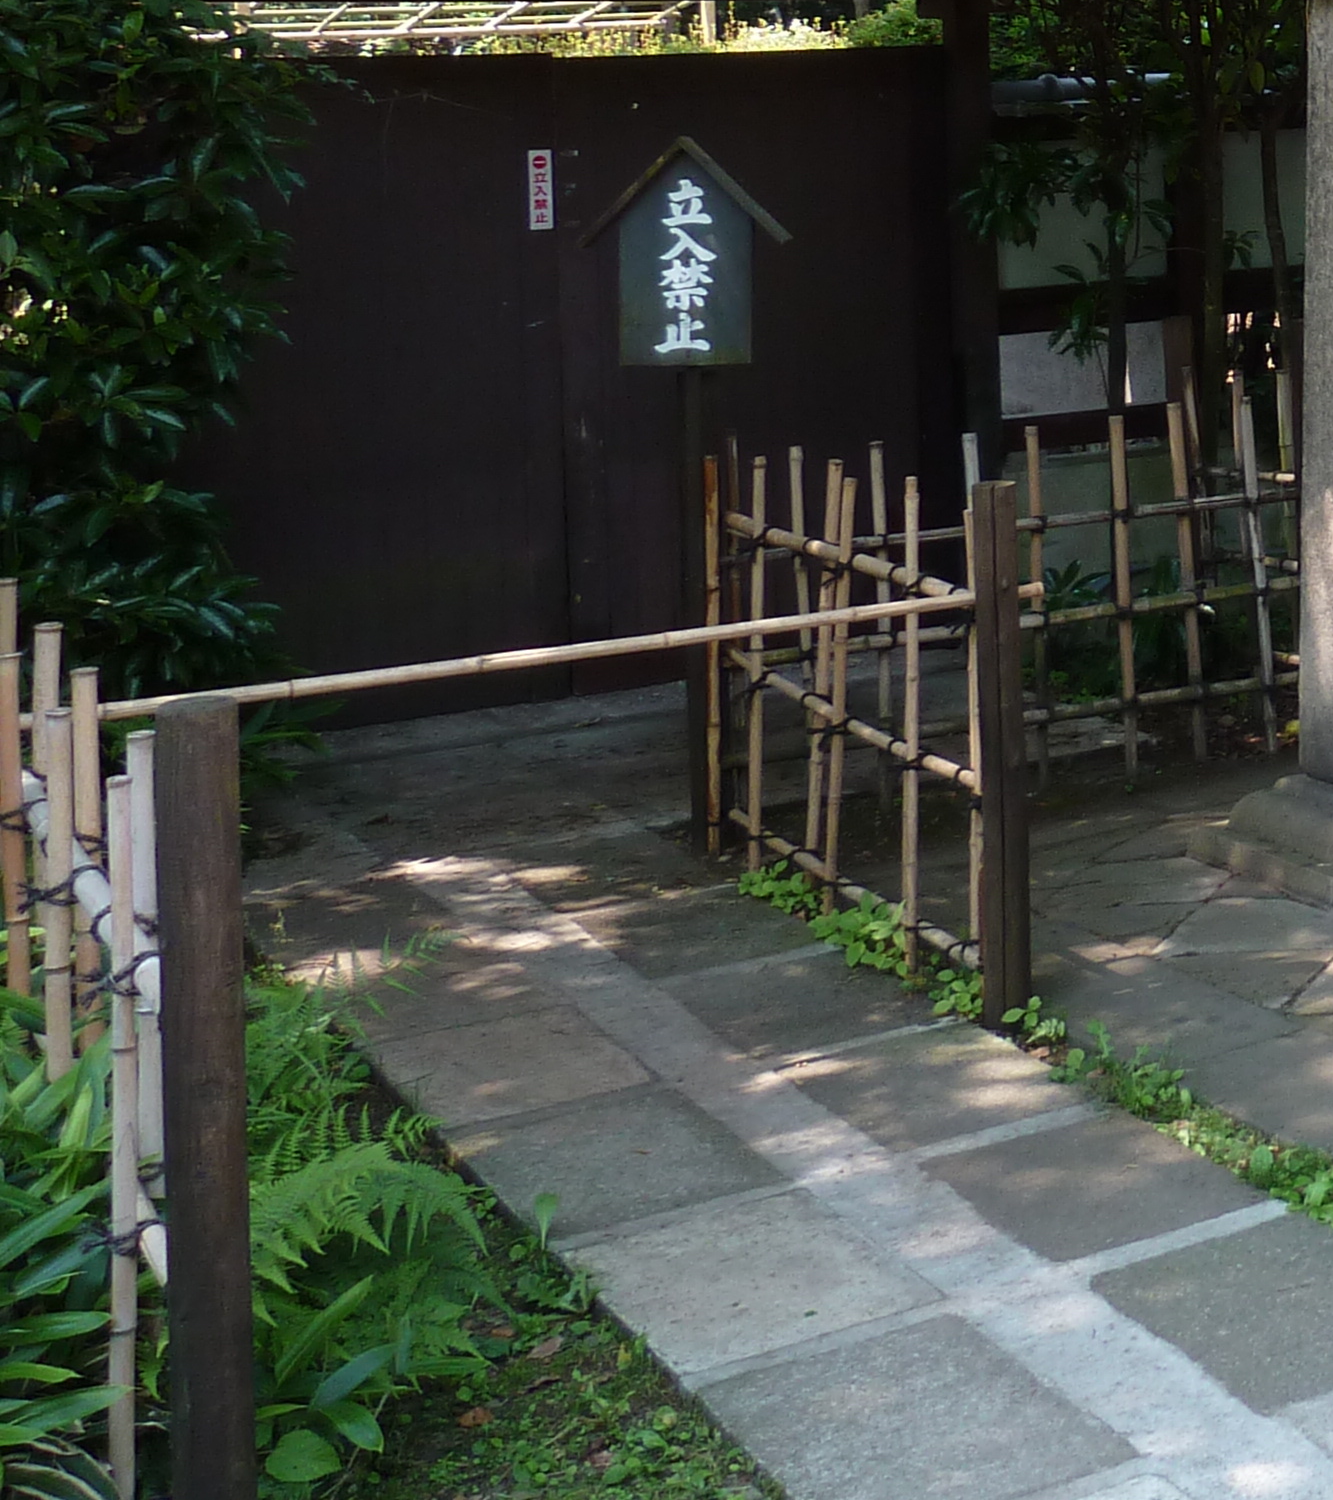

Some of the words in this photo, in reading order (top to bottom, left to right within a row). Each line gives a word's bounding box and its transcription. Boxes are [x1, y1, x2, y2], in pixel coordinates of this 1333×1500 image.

[533, 171, 549, 224] 立入禁止
[653, 179, 718, 353] 立入禁止
